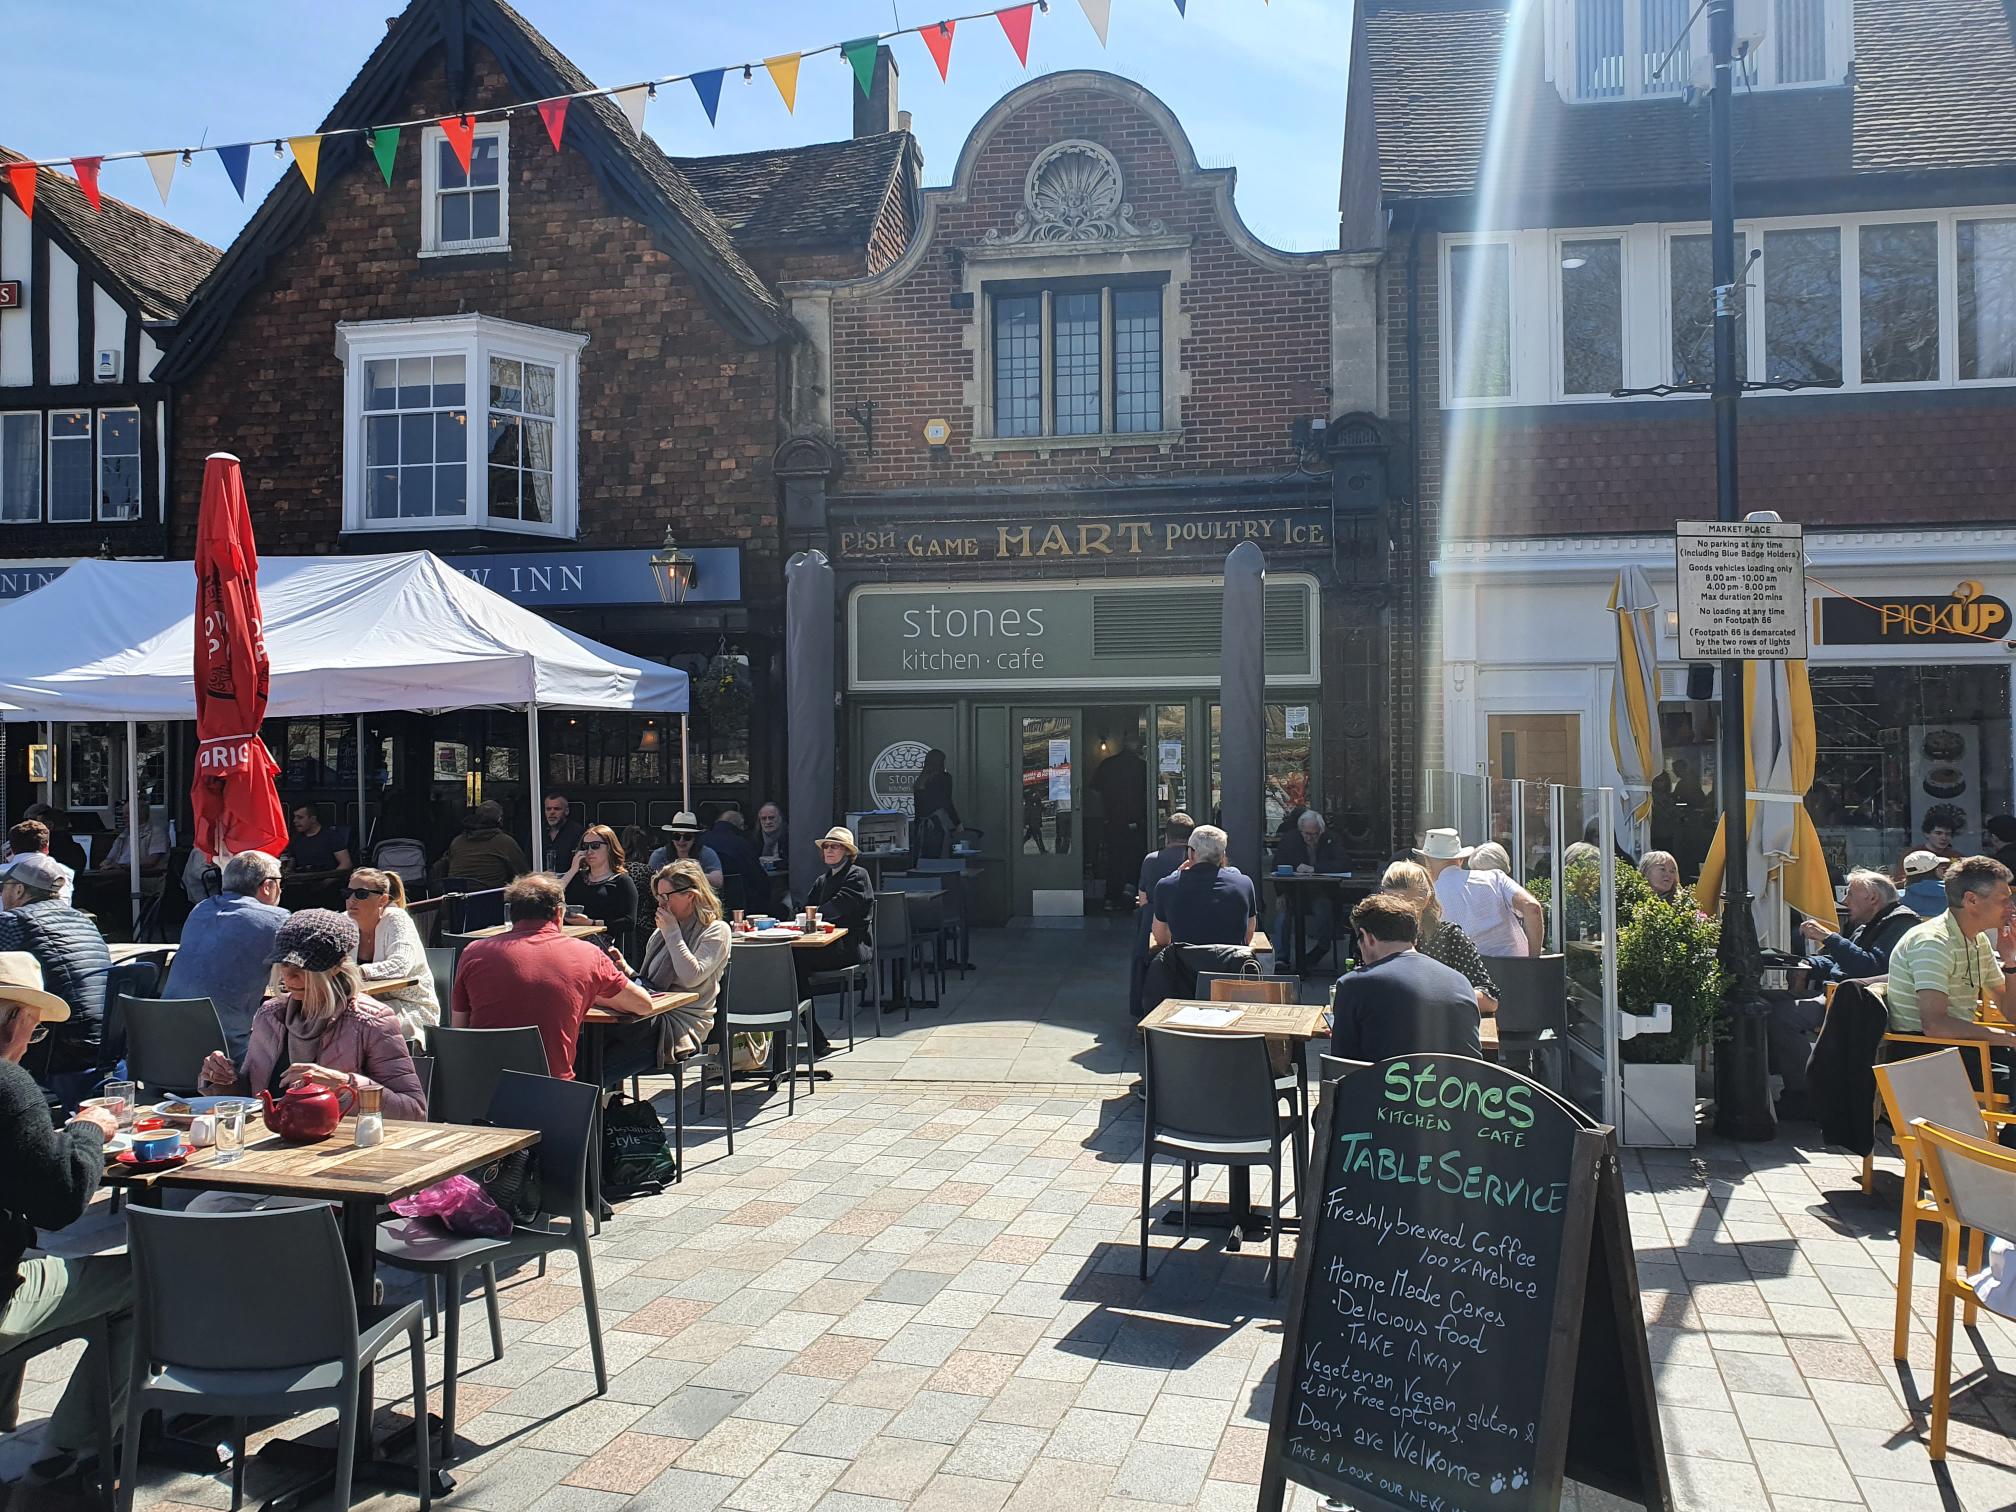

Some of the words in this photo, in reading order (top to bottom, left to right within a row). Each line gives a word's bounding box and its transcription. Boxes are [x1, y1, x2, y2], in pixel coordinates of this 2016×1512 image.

[840, 531, 896, 552] FISH
[907, 534, 979, 557] GAME
[996, 522, 1153, 557] HART
[1165, 519, 1276, 550] POULTRY
[1708, 525, 1742, 533] MARKET
[1745, 526, 1771, 534] PLACE
[1710, 540, 1738, 548] parking
[1722, 549, 1738, 557] Blue
[1742, 550, 1764, 558] Badge
[1767, 550, 1800, 558] Holders)
[510, 565, 584, 593] INN
[1688, 564, 1712, 572] Goods
[1714, 564, 1746, 572] vehicles
[1747, 564, 1774, 573] loading
[1776, 565, 1792, 573] only
[1705, 574, 1724, 582] 8.00
[1742, 574, 1765, 582] 10.00
[903, 604, 1044, 638] stones
[1712, 608, 1740, 616] loading
[1726, 616, 1760, 625] Footpath
[1881, 603, 2005, 634] PICKUP
[1689, 628, 1729, 637] (Footpath
[1752, 628, 1796, 636] demarcated
[1696, 638, 1704, 646] by
[1708, 638, 1720, 646] the
[1760, 638, 1768, 646] of
[1769, 638, 1790, 646] lights
[903, 648, 980, 671] kitchen
[997, 647, 1044, 670] cafe
[1758, 648, 1788, 656] ground)
[888, 775, 920, 784] ston
[1377, 1106, 1452, 1132] KITCHEN
[1477, 1127, 1526, 1148] CAFE
[1472, 1231, 1537, 1268] Coffee
[1328, 1255, 1386, 1294] Home
[1390, 1269, 1441, 1307] Made
[1449, 1290, 1506, 1328] Cakes
[1337, 1288, 1428, 1336] Delicious
[1435, 1314, 1489, 1354] food
[1347, 1323, 1395, 1357] TAKE
[1407, 1339, 1462, 1385] AWAY
[1300, 1374, 1347, 1410] dairy
[1352, 1385, 1385, 1411] free
[1297, 1401, 1343, 1443] Dogs
[1354, 1427, 1384, 1451] are
[1467, 1403, 1519, 1440] gluten
[1289, 1436, 1317, 1461] TAKE
[1321, 1452, 1330, 1464] A
[1379, 1478, 1404, 1497] OUR
[1409, 1489, 1446, 1512] NEW
